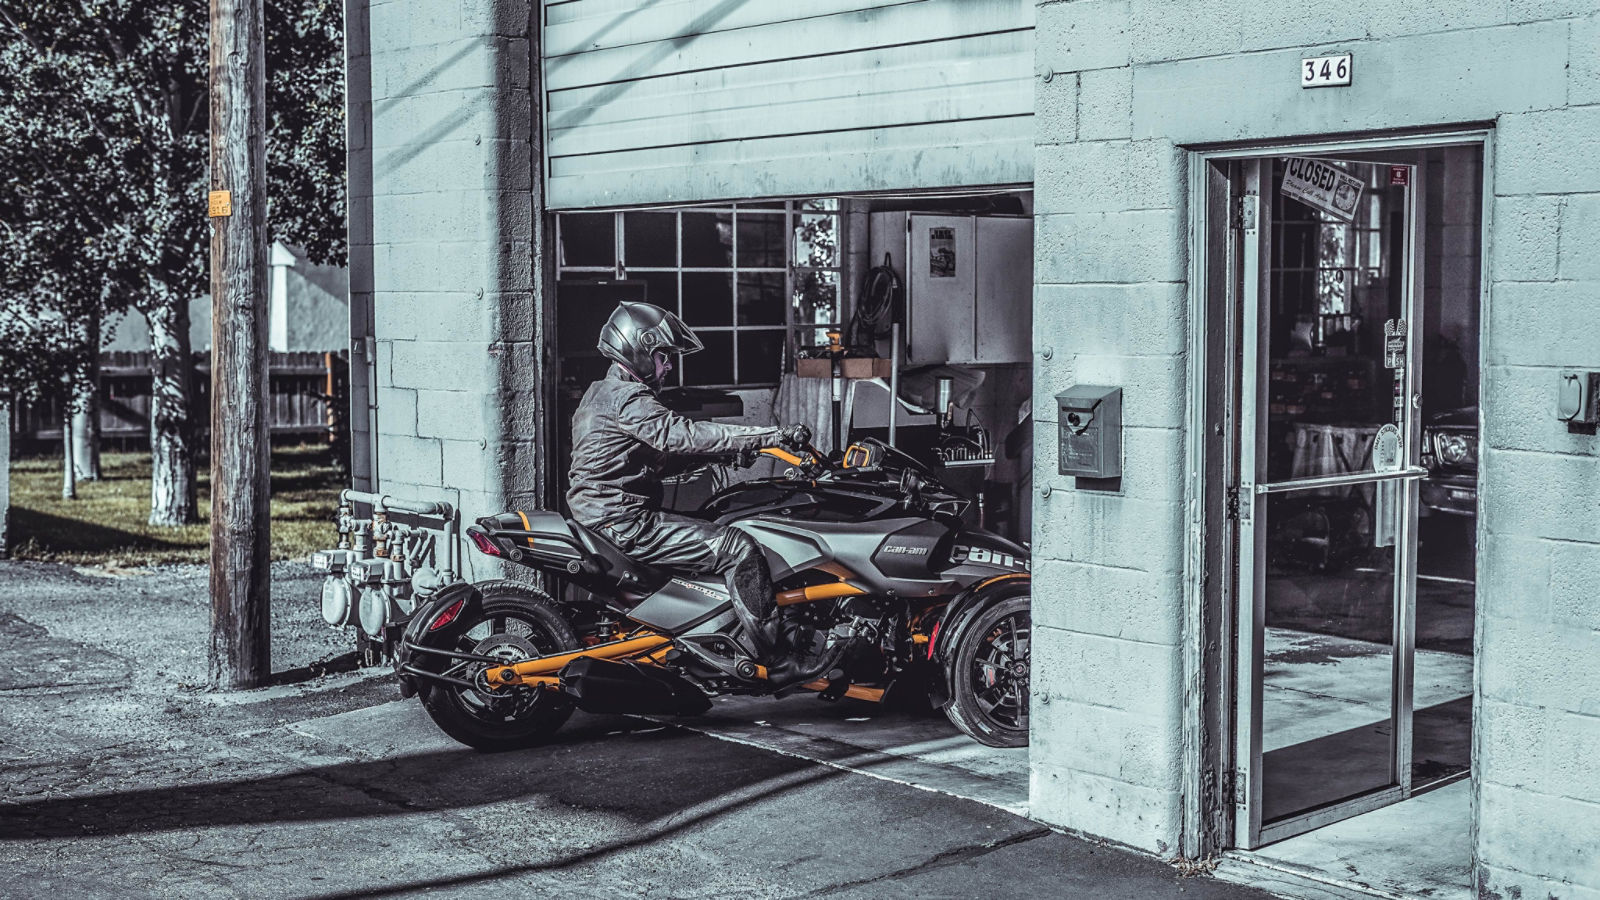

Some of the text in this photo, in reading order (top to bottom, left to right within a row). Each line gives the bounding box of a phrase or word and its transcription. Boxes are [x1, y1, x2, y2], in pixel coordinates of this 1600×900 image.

[1305, 58, 1346, 81] 346
[1290, 158, 1336, 191] CLOSED
[1387, 357, 1404, 367] PSH
[884, 545, 928, 556] can-am
